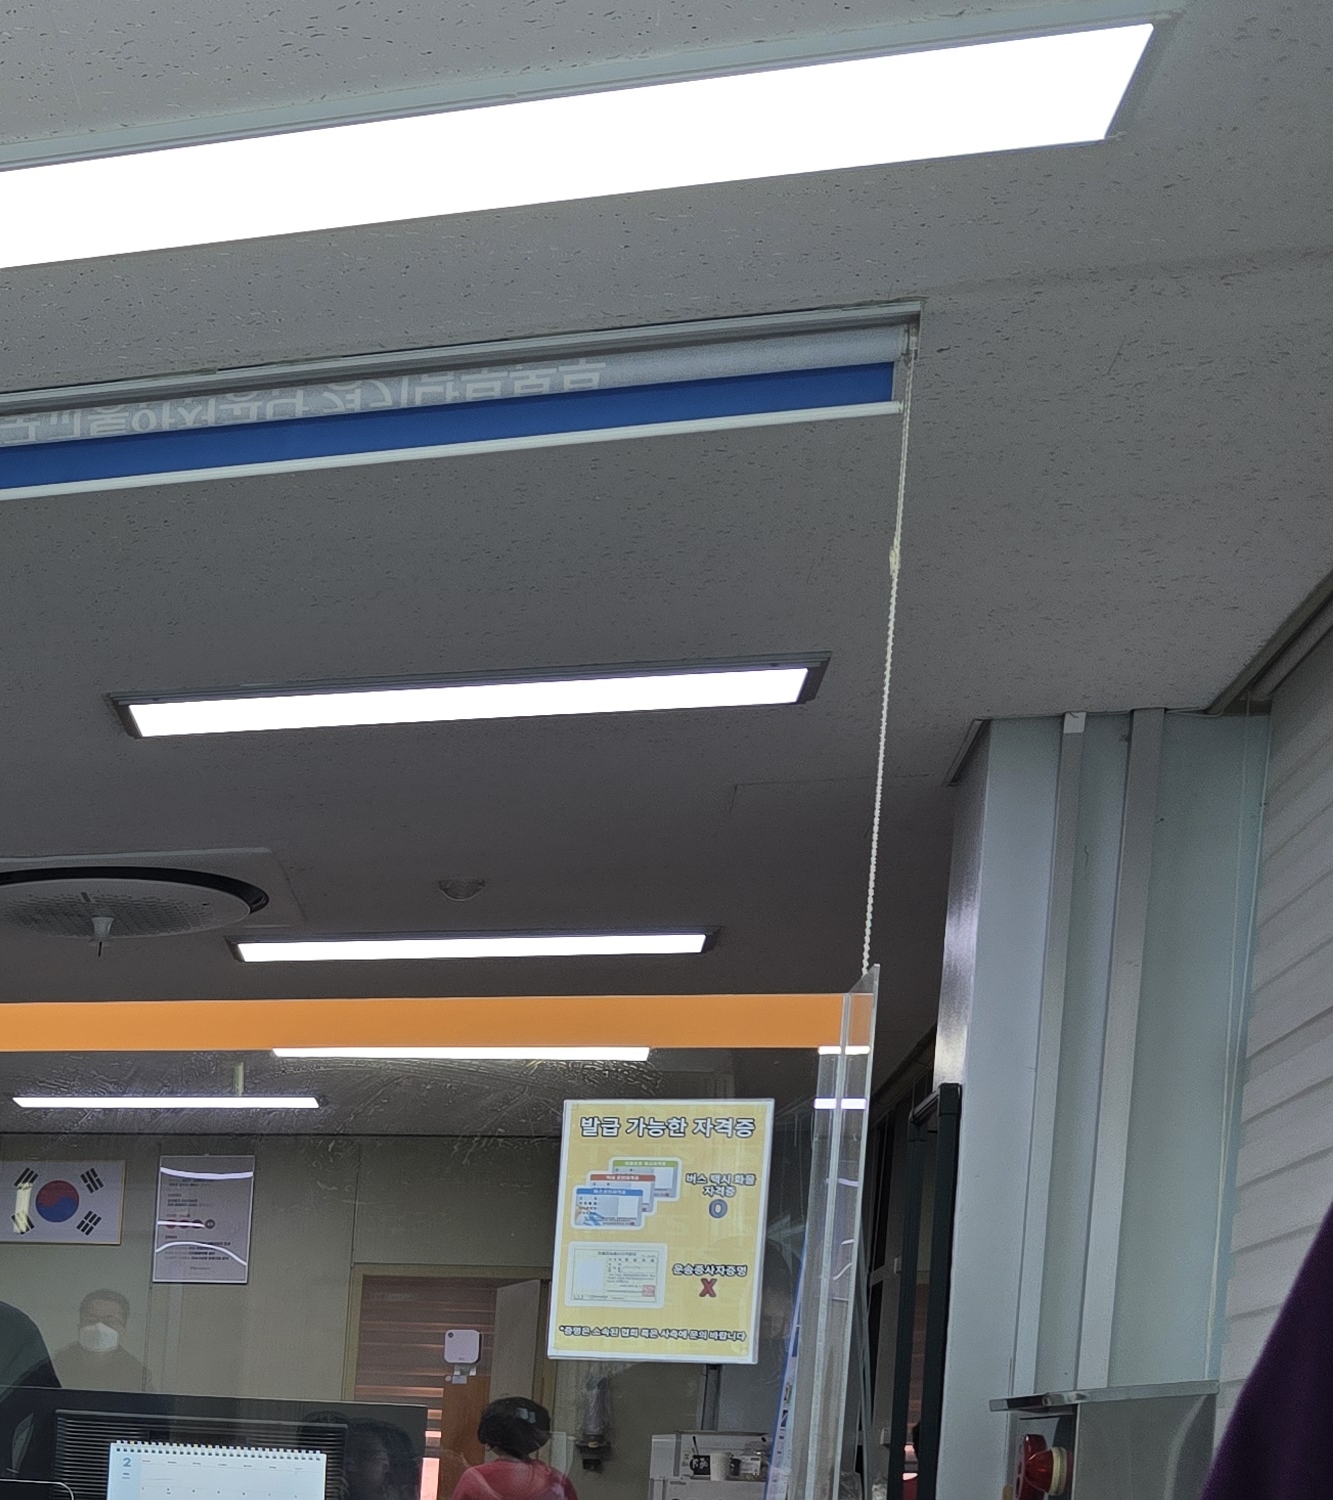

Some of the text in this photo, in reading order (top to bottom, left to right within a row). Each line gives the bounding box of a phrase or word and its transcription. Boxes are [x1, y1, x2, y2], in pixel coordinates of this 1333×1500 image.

[579, 1116, 756, 1138] 발급 가능한 자격증
